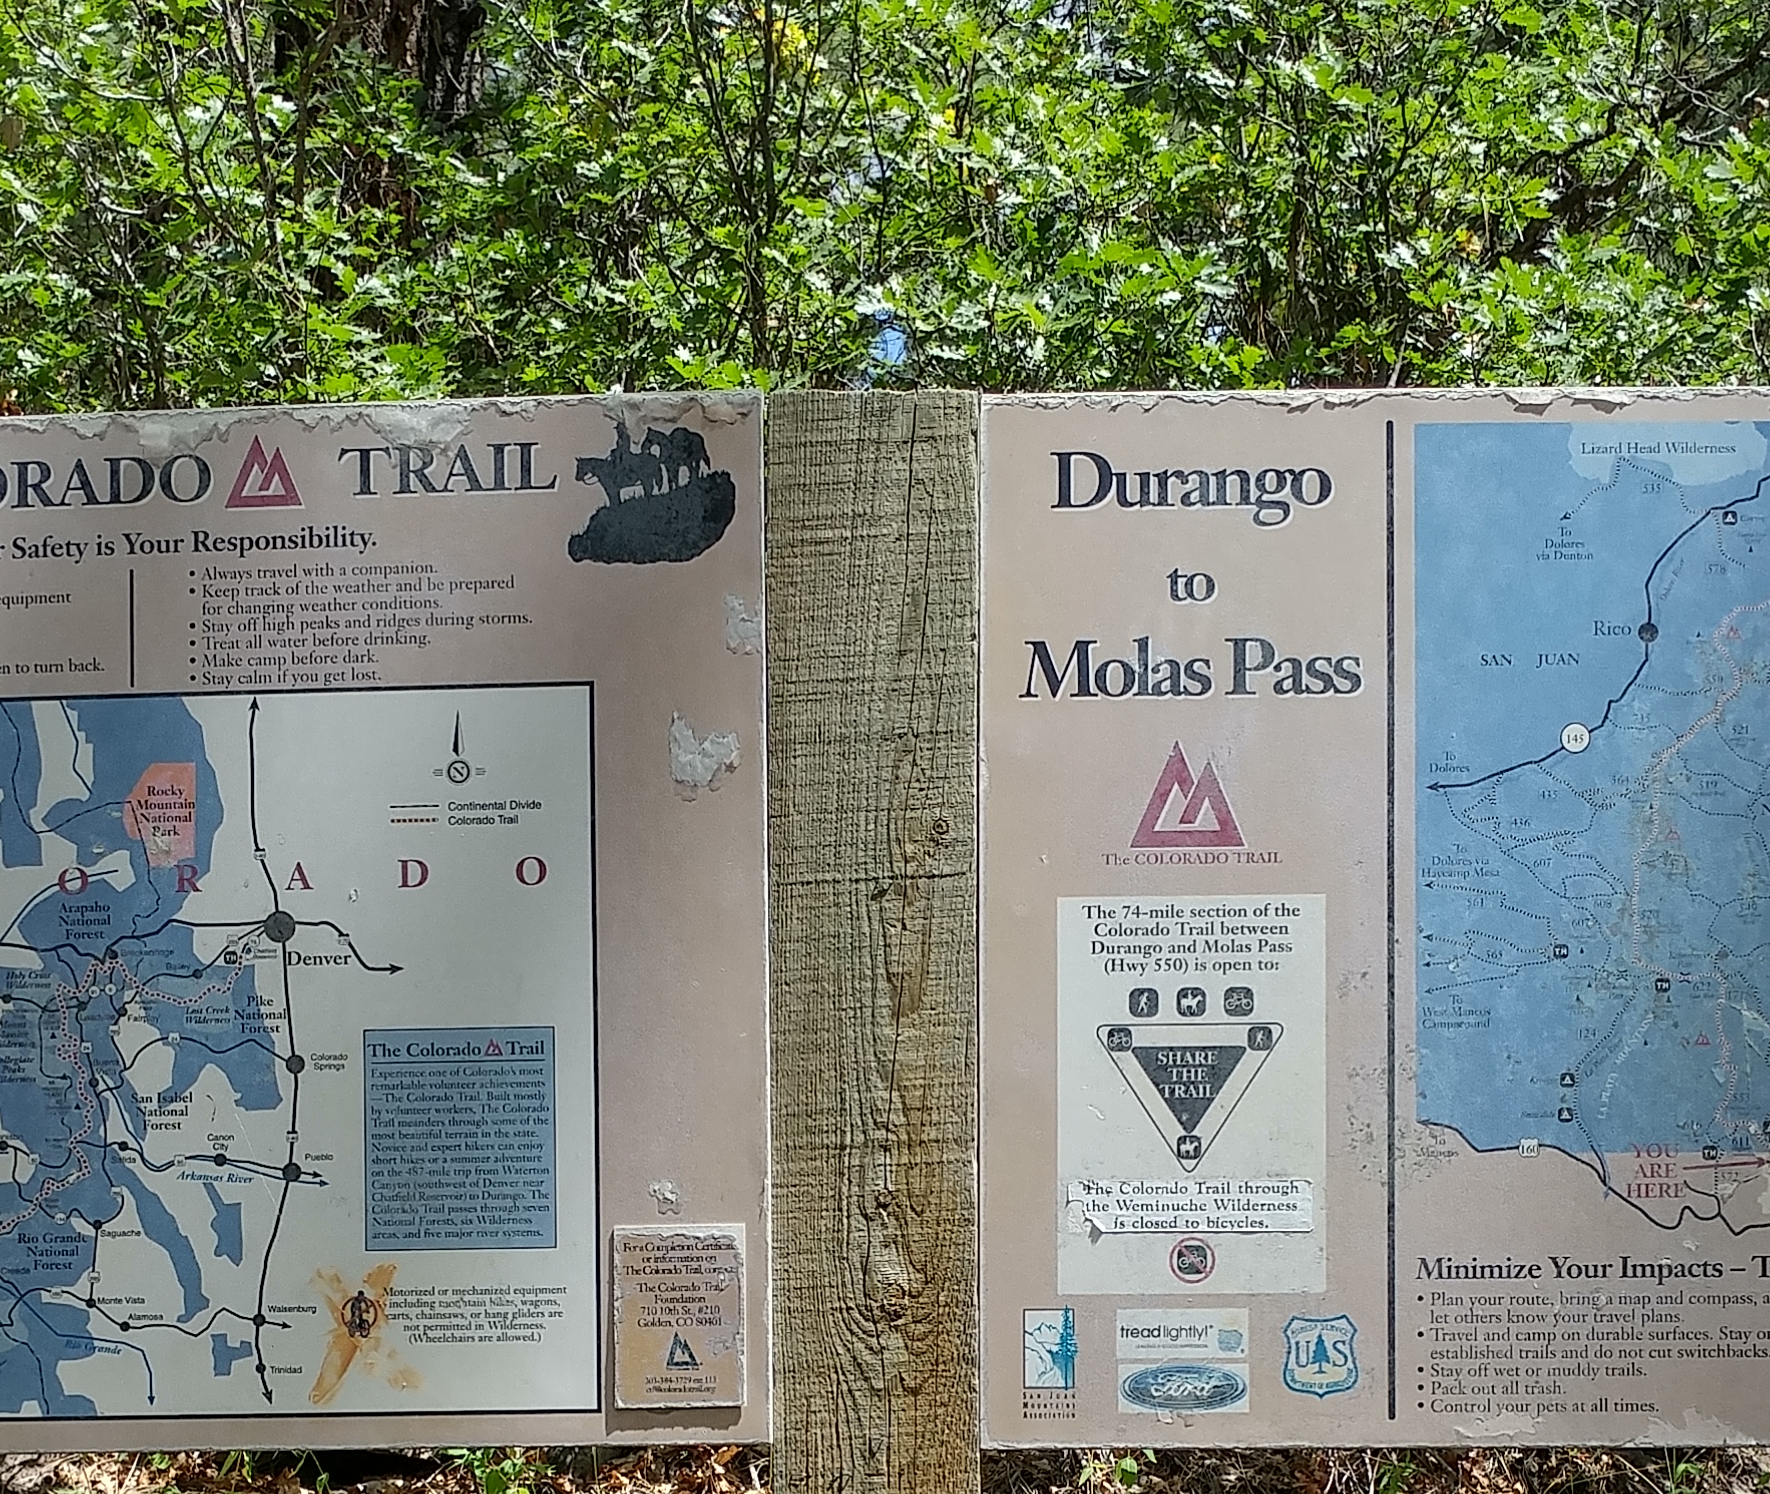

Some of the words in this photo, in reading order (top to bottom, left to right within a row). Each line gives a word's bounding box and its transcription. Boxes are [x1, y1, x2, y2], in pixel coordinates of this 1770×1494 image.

[1581, 442, 1623, 455] Lizard
[1627, 442, 1661, 455] Head
[1665, 441, 1736, 454] Wilderness
[337, 442, 558, 496] TRAIL
[1050, 451, 1333, 527] Durango
[11, 536, 89, 563] Safety
[95, 534, 115, 556] is
[121, 531, 184, 556] Your
[191, 526, 377, 558] Responsibility.
[202, 567, 252, 582] Always
[258, 565, 298, 578] travel
[302, 564, 334, 577] with
[339, 567, 347, 576] a
[351, 562, 438, 579] companion.
[1166, 568, 1216, 601] to
[1593, 621, 1632, 636] Rico
[202, 654, 242, 668] Make
[247, 654, 287, 671] camp
[291, 651, 338, 665] before
[342, 650, 378, 665] dark.
[1019, 636, 1212, 698] Molas
[1225, 637, 1362, 696] Pass
[1481, 654, 1513, 667] SAN
[1536, 653, 1580, 667] JUAN
[1566, 733, 1584, 745] 145
[147, 785, 184, 799] Rocky
[137, 798, 195, 811] Mountain
[447, 800, 506, 811] Continental
[509, 800, 542, 810] Divide
[140, 812, 192, 825] National
[448, 814, 495, 827] Colorado
[498, 814, 519, 825] Trail
[1102, 853, 1131, 865] The
[1134, 852, 1228, 865] COLORADO
[1233, 851, 1283, 864] TRAIL
[1083, 906, 1117, 920] The
[1122, 905, 1184, 920] 74-mile
[1190, 905, 1247, 919] section
[1253, 904, 1272, 918] of
[1275, 904, 1300, 918] the
[1094, 924, 1170, 938] Colorado
[1175, 922, 1215, 936] Trail
[1220, 922, 1289, 936] between
[1091, 941, 1162, 958] Durango
[1167, 940, 1197, 954] and
[1202, 940, 1252, 954] Molas
[1257, 940, 1293, 953] Pass
[286, 950, 352, 968] Denver
[1104, 958, 1147, 976] (Hwy
[1153, 958, 1189, 974] 550)
[1194, 958, 1207, 972] is
[1212, 960, 1252, 975] open
[1257, 959, 1279, 972] to:
[246, 996, 274, 1008] Pike
[234, 1009, 286, 1021] National
[240, 1022, 281, 1035] Forest
[367, 1044, 401, 1058] The
[407, 1042, 481, 1058] Colorado
[506, 1040, 545, 1056] Trail
[311, 1052, 348, 1062] Colorado
[1158, 1051, 1217, 1064] SHARE
[313, 1062, 345, 1072] Springs
[1167, 1068, 1207, 1081] THE
[1159, 1084, 1216, 1098] TRAIL
[213, 1142, 229, 1152] City
[1521, 1143, 1538, 1154] 160
[1631, 1145, 1680, 1158] YOU
[305, 1153, 333, 1162] Pueblo
[177, 1171, 221, 1183] Arkansas
[224, 1173, 254, 1184] River
[1635, 1164, 1677, 1179] ARE
[1625, 1183, 1686, 1199] HERE
[100, 1229, 141, 1239] Saguache
[1416, 1258, 1542, 1280] Minimize
[1548, 1257, 1614, 1280] Your
[1619, 1256, 1724, 1285] Impacts
[98, 1296, 122, 1305] Monte
[125, 1296, 145, 1305] Vista
[655, 1296, 705, 1304] Foundation
[267, 1304, 317, 1315] Walsenburg
[640, 1307, 657, 1316] 710
[661, 1306, 679, 1315] 10th
[682, 1306, 695, 1316] St.,
[698, 1306, 720, 1314] #210
[127, 1313, 163, 1321] Alamosa
[1295, 1341, 1310, 1368] U
[1331, 1340, 1349, 1368] S
[270, 1365, 303, 1374] Trinidad
[1151, 1373, 1223, 1398] Ford
[1431, 1382, 1466, 1395] Pack
[1472, 1384, 1497, 1395] out
[1501, 1381, 1519, 1394] all
[1524, 1381, 1566, 1395] trash.
